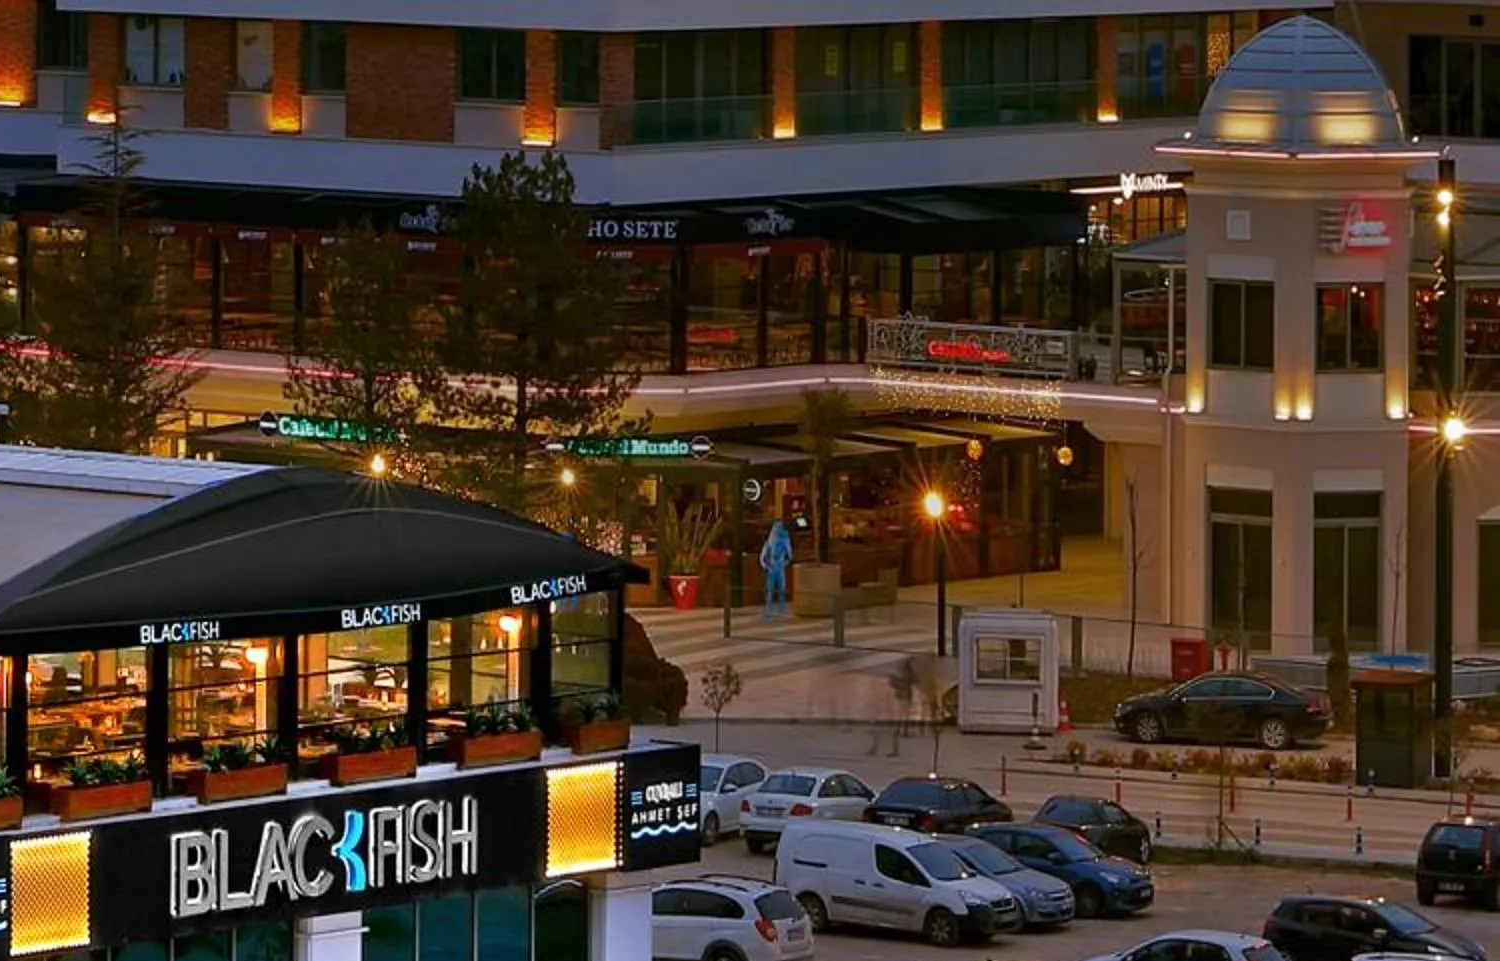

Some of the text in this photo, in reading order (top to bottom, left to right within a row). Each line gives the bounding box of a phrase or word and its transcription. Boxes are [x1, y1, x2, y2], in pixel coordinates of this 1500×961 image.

[622, 219, 677, 239] SETE
[279, 415, 314, 437] Cafe
[631, 439, 689, 455] Mundo
[631, 807, 671, 825] AHMET
